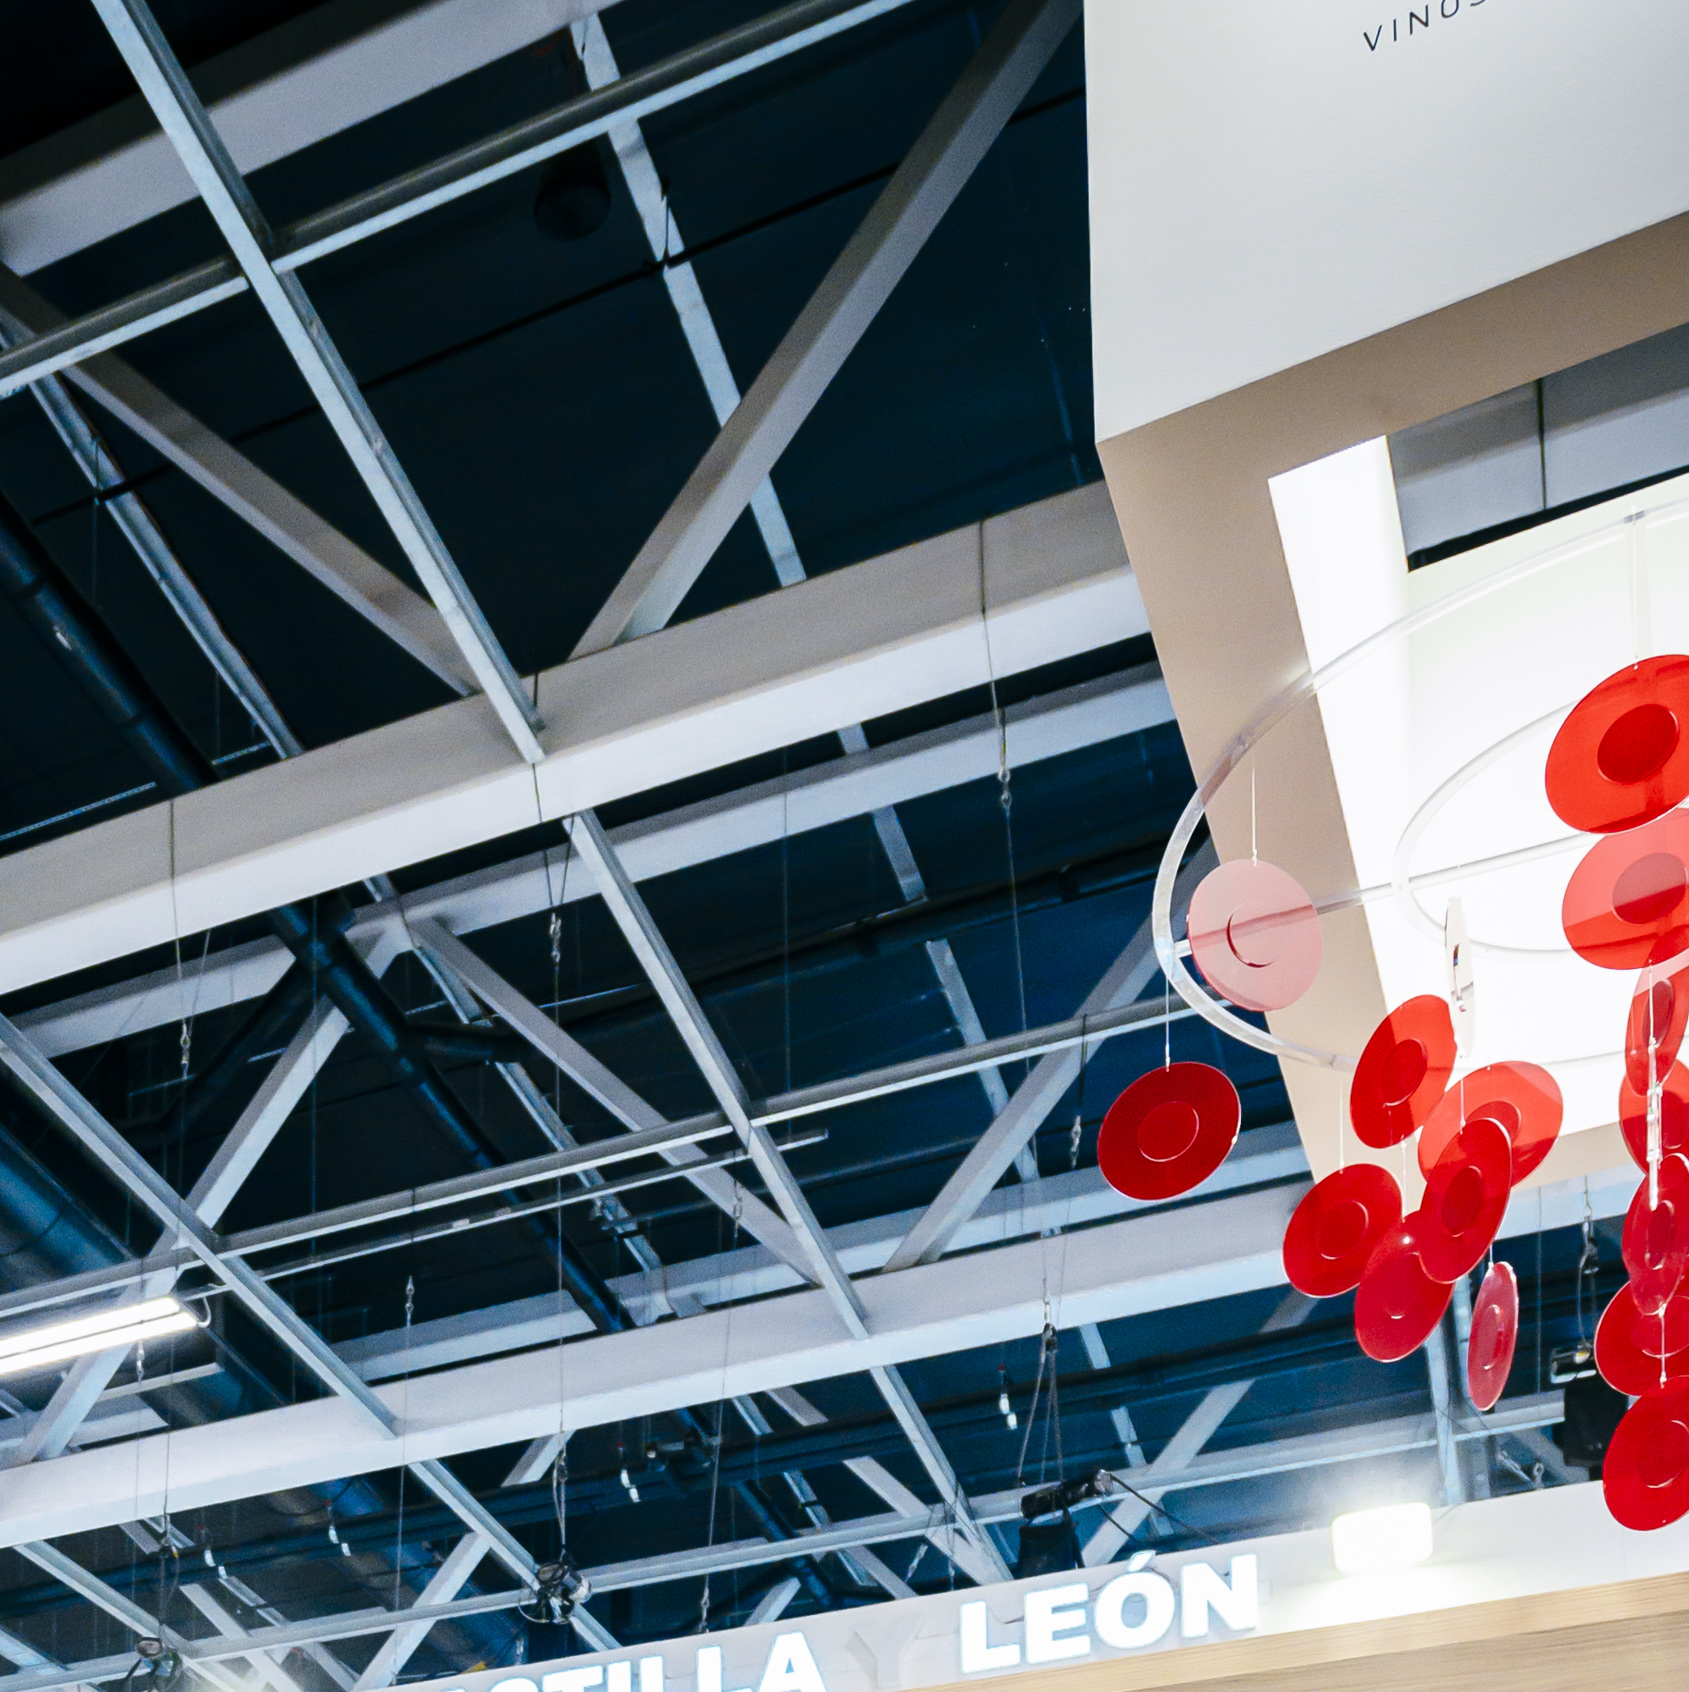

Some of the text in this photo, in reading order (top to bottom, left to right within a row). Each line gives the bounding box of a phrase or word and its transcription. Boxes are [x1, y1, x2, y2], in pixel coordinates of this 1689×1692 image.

[1362, 0, 1487, 51] VINO
[845, 1617, 930, 1691] Y
[957, 1550, 1262, 1675] LEÓN
